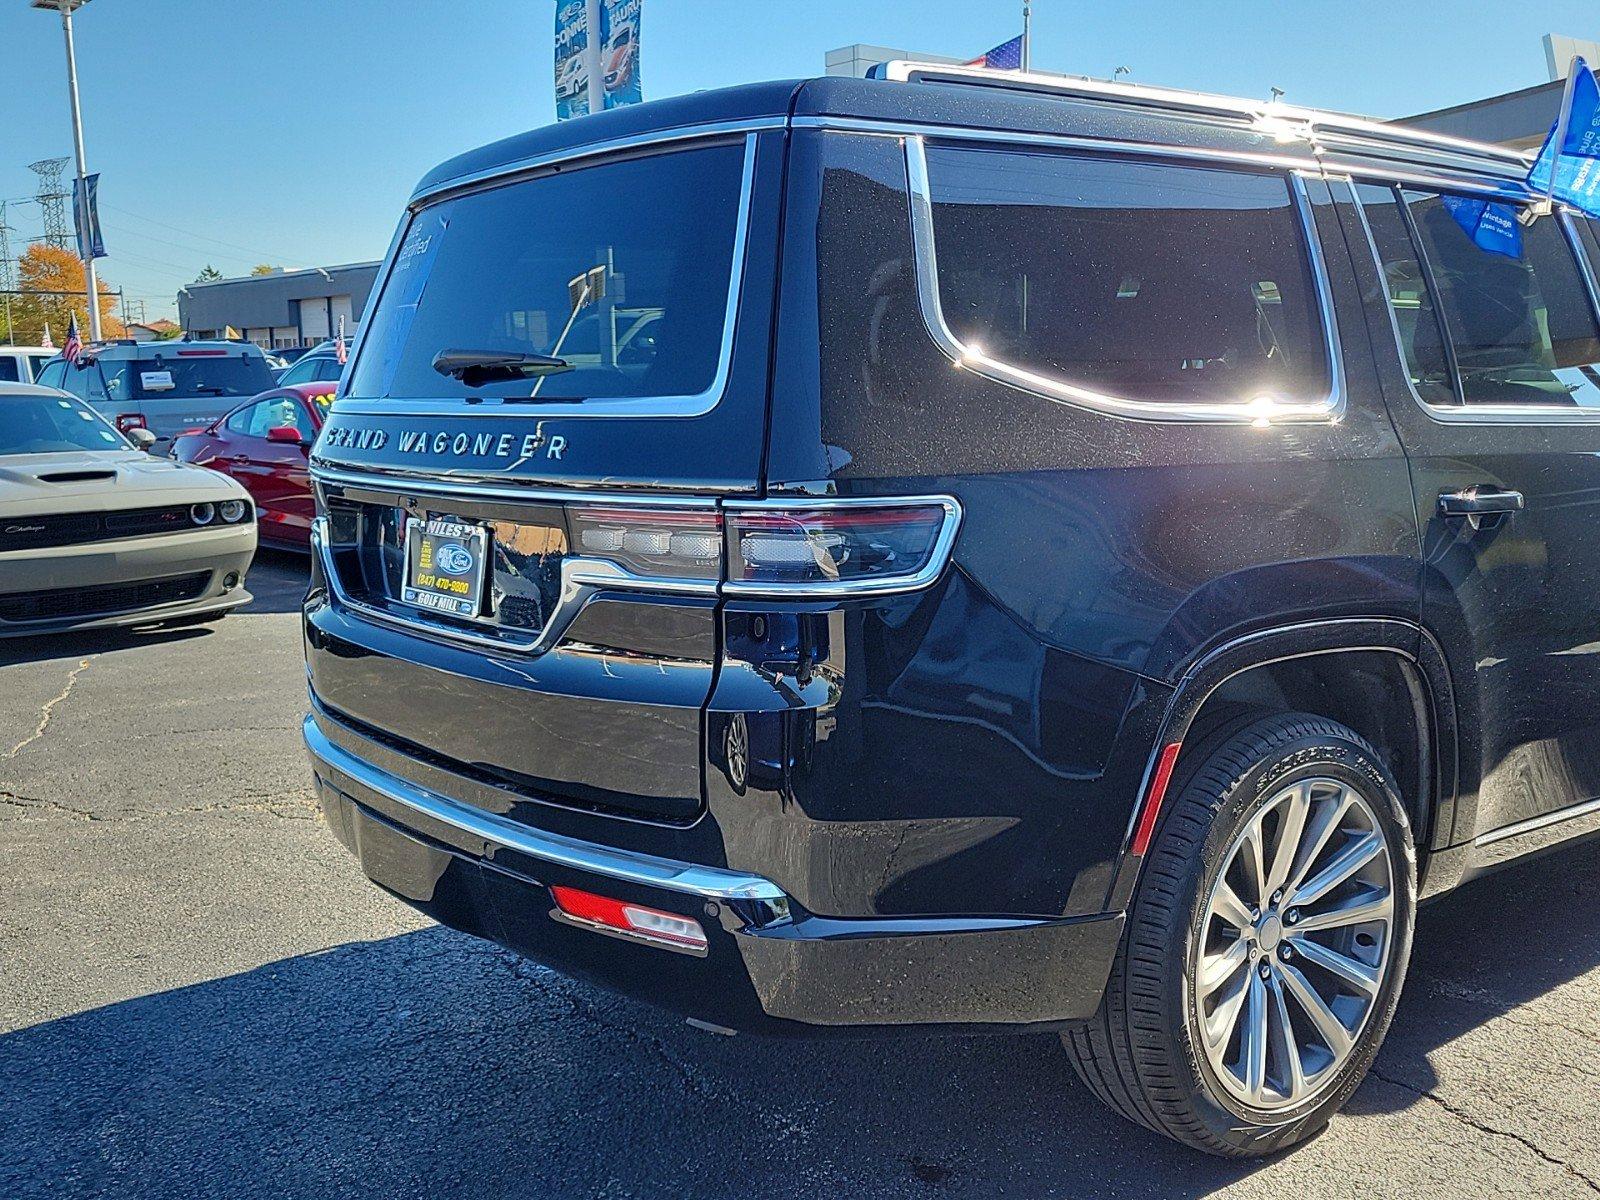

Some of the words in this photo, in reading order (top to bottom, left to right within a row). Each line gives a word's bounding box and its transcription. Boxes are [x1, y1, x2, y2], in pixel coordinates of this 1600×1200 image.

[325, 427, 386, 450] GRAND
[398, 430, 568, 460] WAGONEER
[426, 520, 463, 537] NILES
[417, 592, 438, 606] GOLF
[437, 597, 457, 611] MILL
